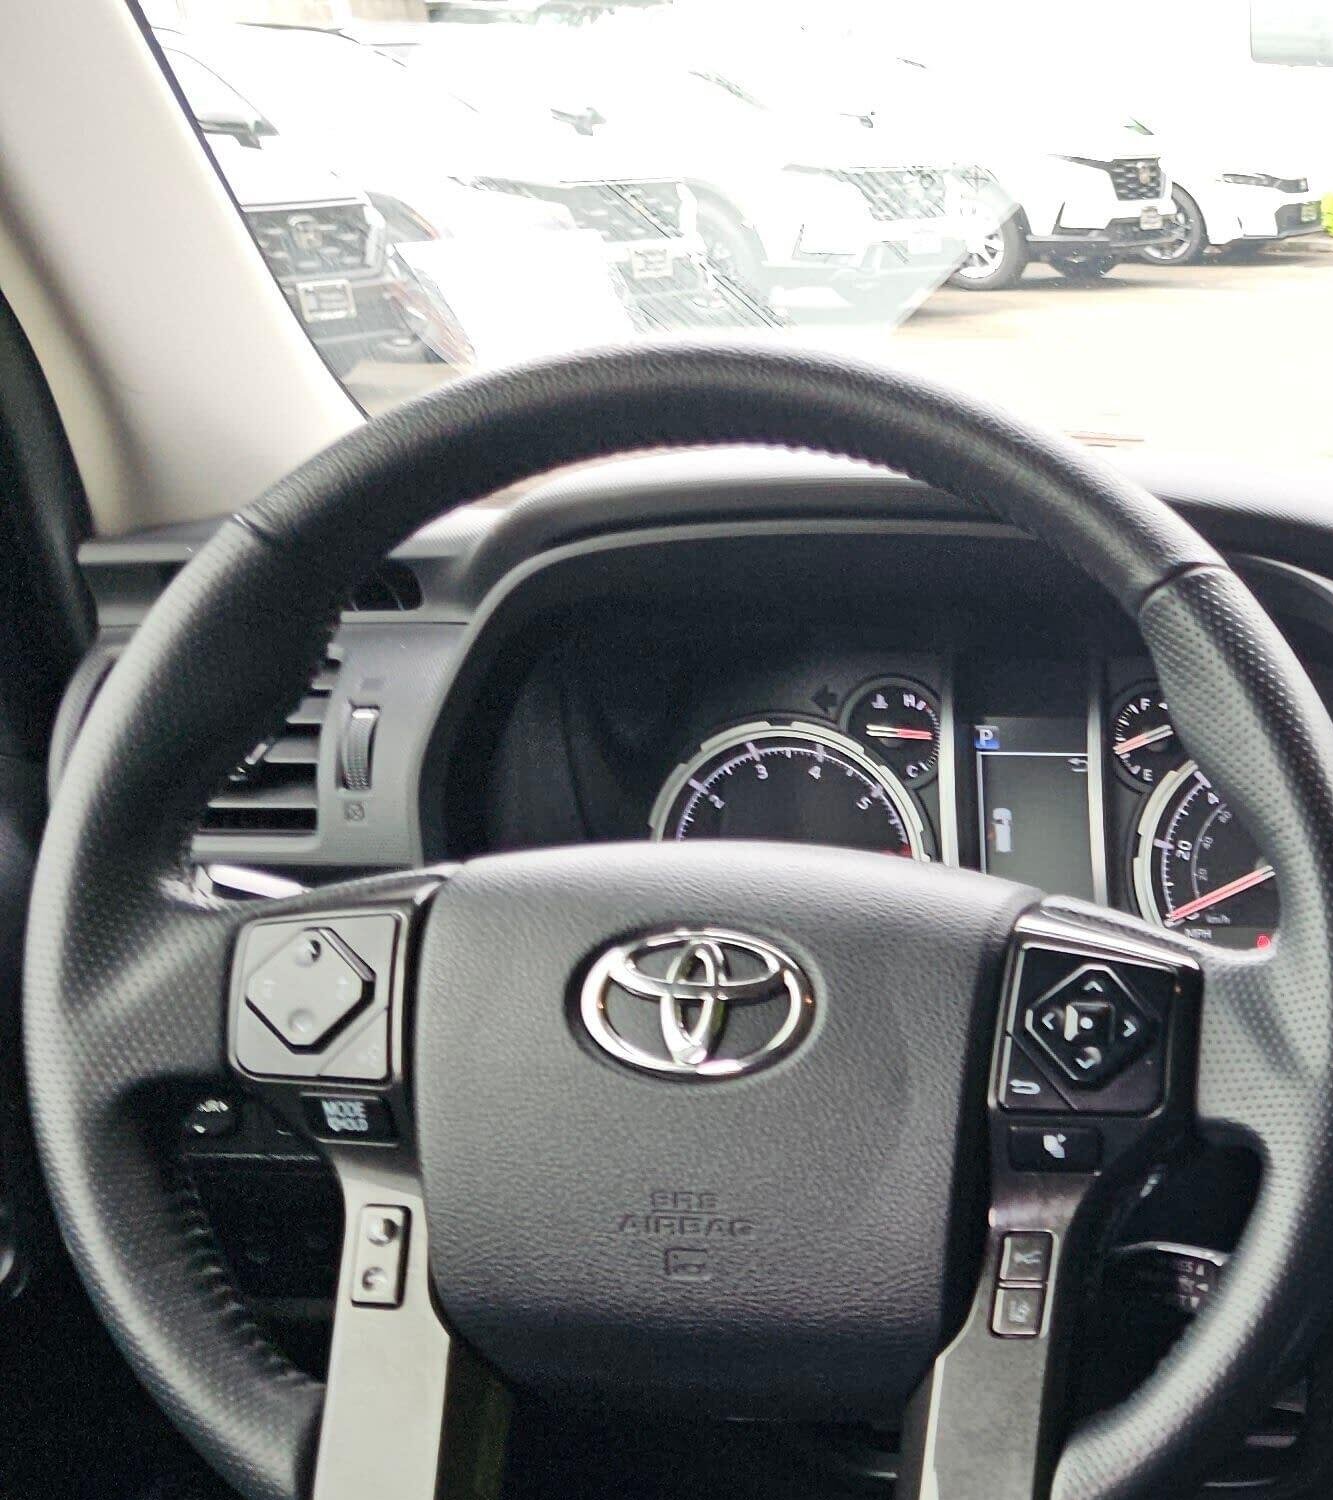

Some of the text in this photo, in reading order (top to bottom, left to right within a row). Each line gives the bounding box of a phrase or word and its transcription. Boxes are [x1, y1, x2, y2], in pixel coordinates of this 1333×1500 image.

[979, 729, 994, 746] P
[756, 764, 768, 780] 3
[808, 765, 821, 780] 4
[1176, 840, 1193, 861] 20
